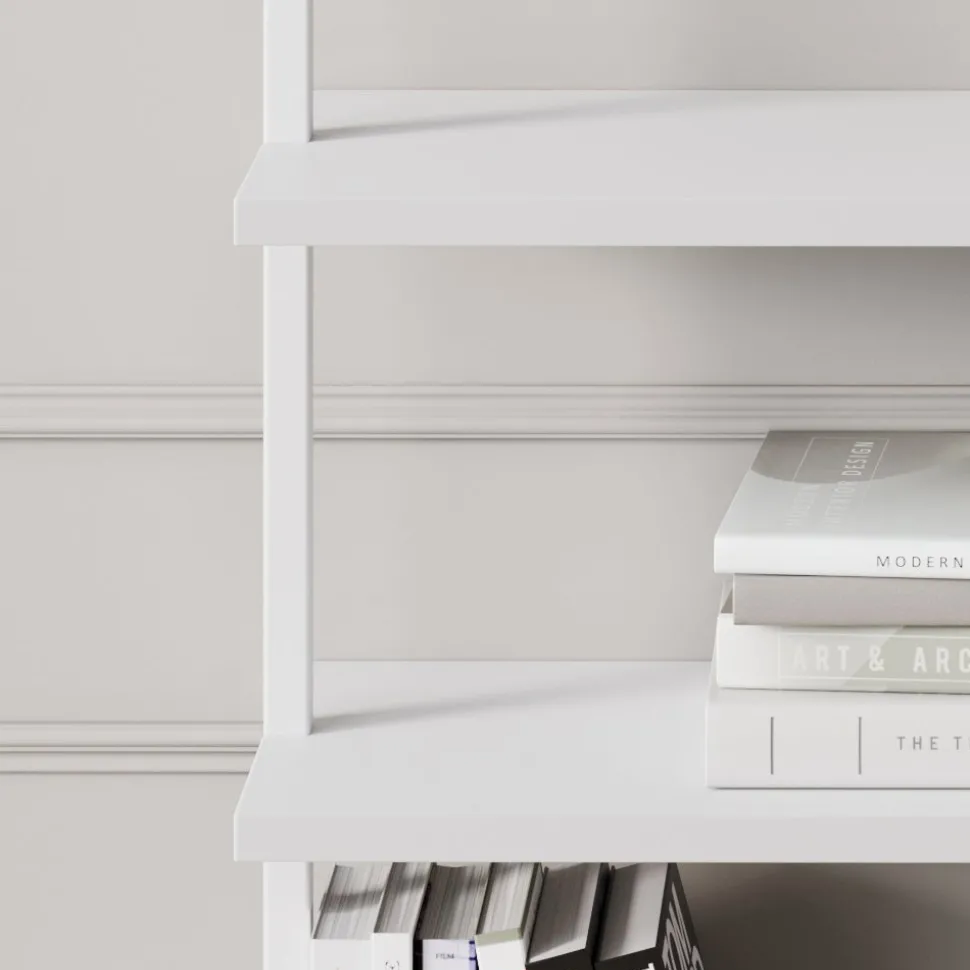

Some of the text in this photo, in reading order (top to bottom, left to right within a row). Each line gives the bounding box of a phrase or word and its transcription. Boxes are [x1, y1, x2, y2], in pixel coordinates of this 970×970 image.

[841, 441, 875, 476] DESIGN
[876, 555, 964, 569] MODERN
[793, 644, 850, 672] ART
[868, 645, 886, 672] &
[897, 736, 939, 750] THE
